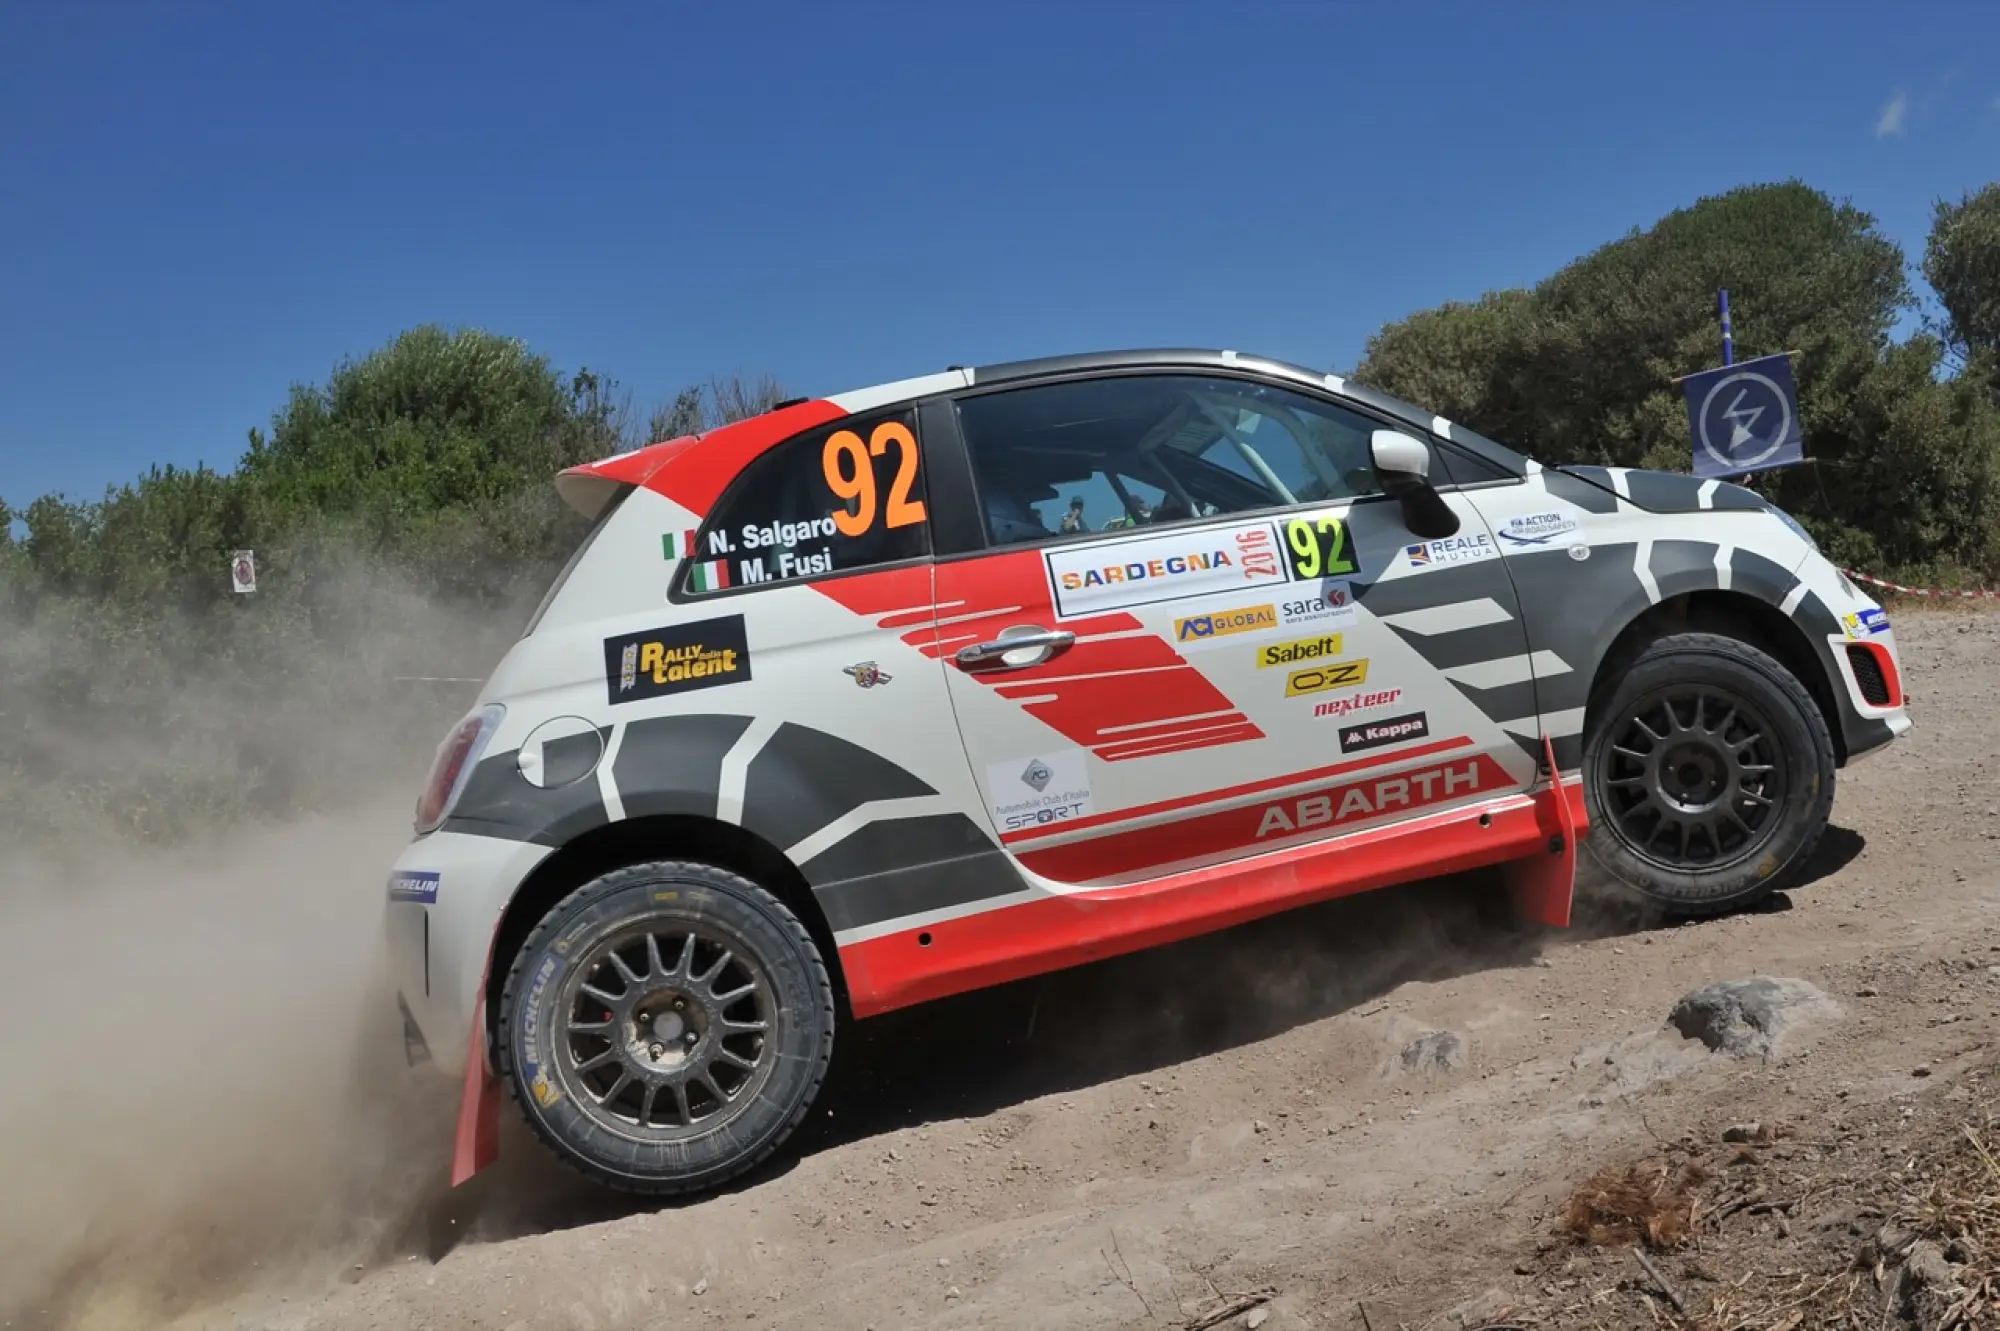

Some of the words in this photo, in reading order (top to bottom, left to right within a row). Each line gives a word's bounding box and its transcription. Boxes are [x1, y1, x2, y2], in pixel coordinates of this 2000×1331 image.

[822, 422, 927, 537] 92
[1526, 513, 1561, 526] ACTION
[708, 529, 736, 556] N.
[742, 516, 837, 549] Salgaro
[1287, 517, 1354, 579] 92
[1431, 534, 1490, 555] REALE
[740, 558, 773, 585] M.
[779, 547, 833, 579] Fusi
[1236, 529, 1279, 581] 2016
[1435, 548, 1492, 564] MUTUA
[1061, 550, 1233, 591] SARDEGNA
[1214, 609, 1275, 630] GLOBAL
[1282, 597, 1325, 616] sara
[1265, 637, 1335, 665] Sabelt
[1314, 688, 1402, 718] nexteer
[1366, 720, 1423, 741] Kappa
[1255, 761, 1480, 838] ABARTH
[1005, 802, 1085, 830] SPORT
[524, 957, 556, 1065] MICHELIN
